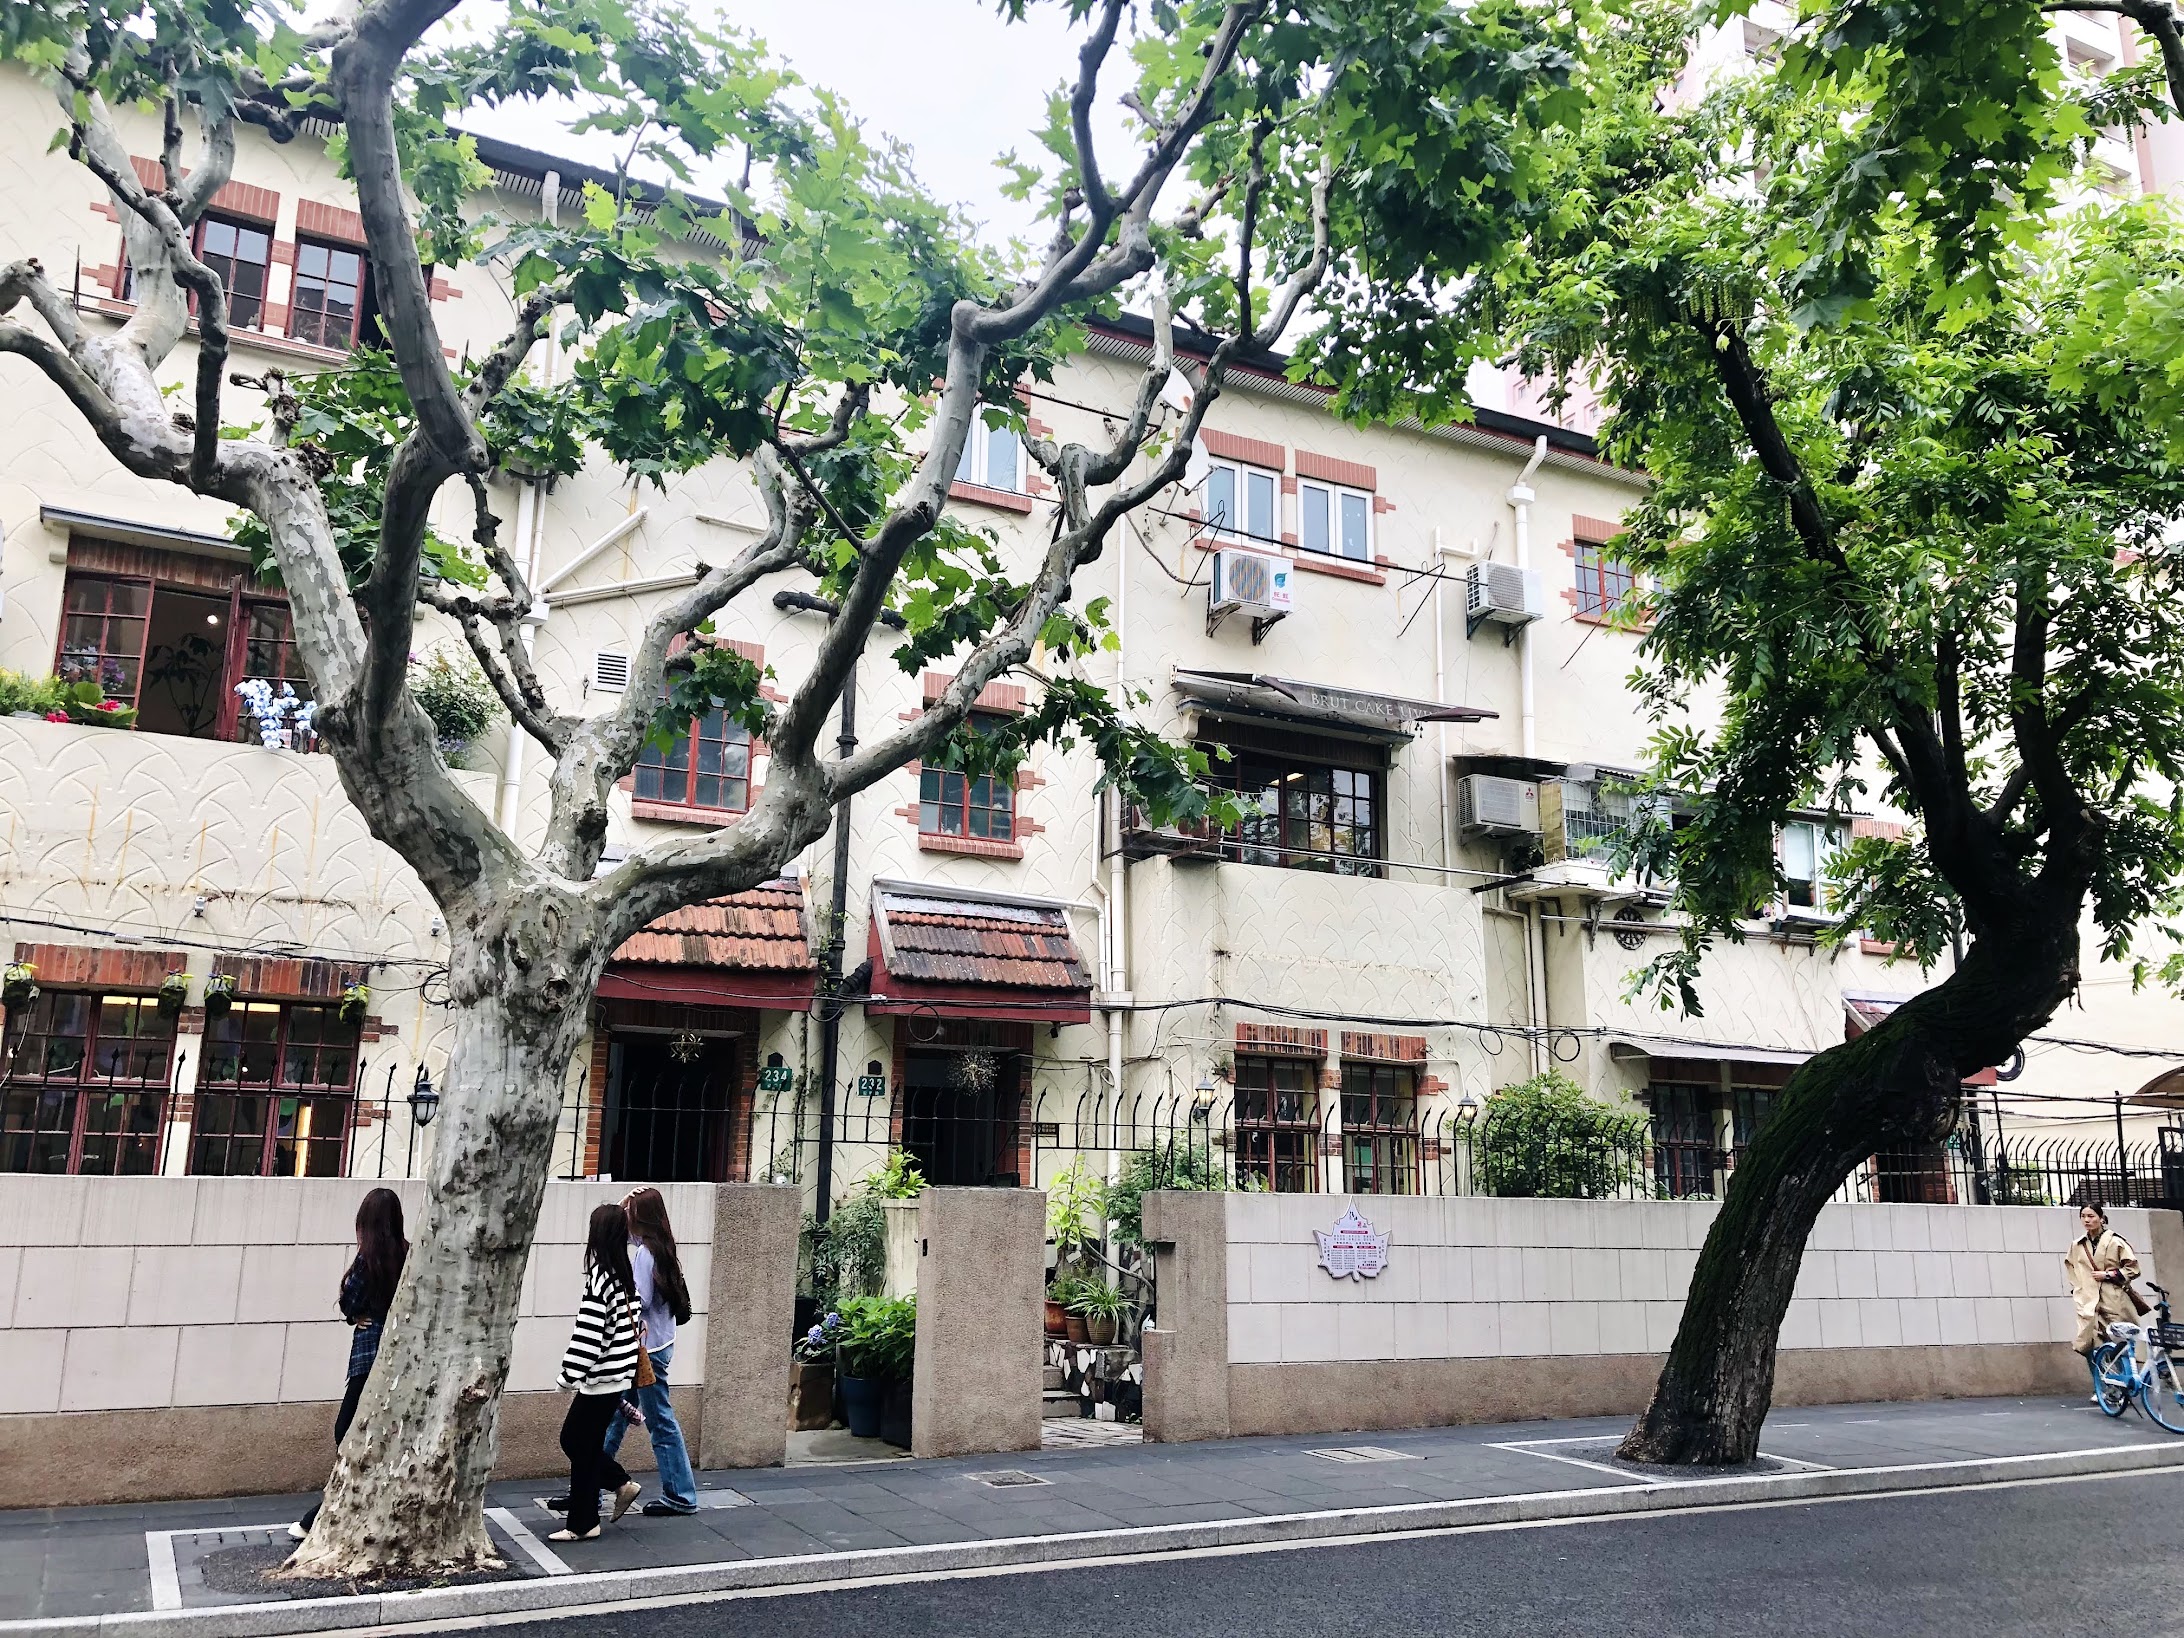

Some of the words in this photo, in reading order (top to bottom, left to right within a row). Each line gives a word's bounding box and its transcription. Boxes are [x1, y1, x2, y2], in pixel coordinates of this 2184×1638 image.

[1311, 693, 1349, 709] BRUT
[1355, 701, 1394, 716] CAKE
[765, 1069, 788, 1082] 234
[861, 1077, 882, 1090] 232
